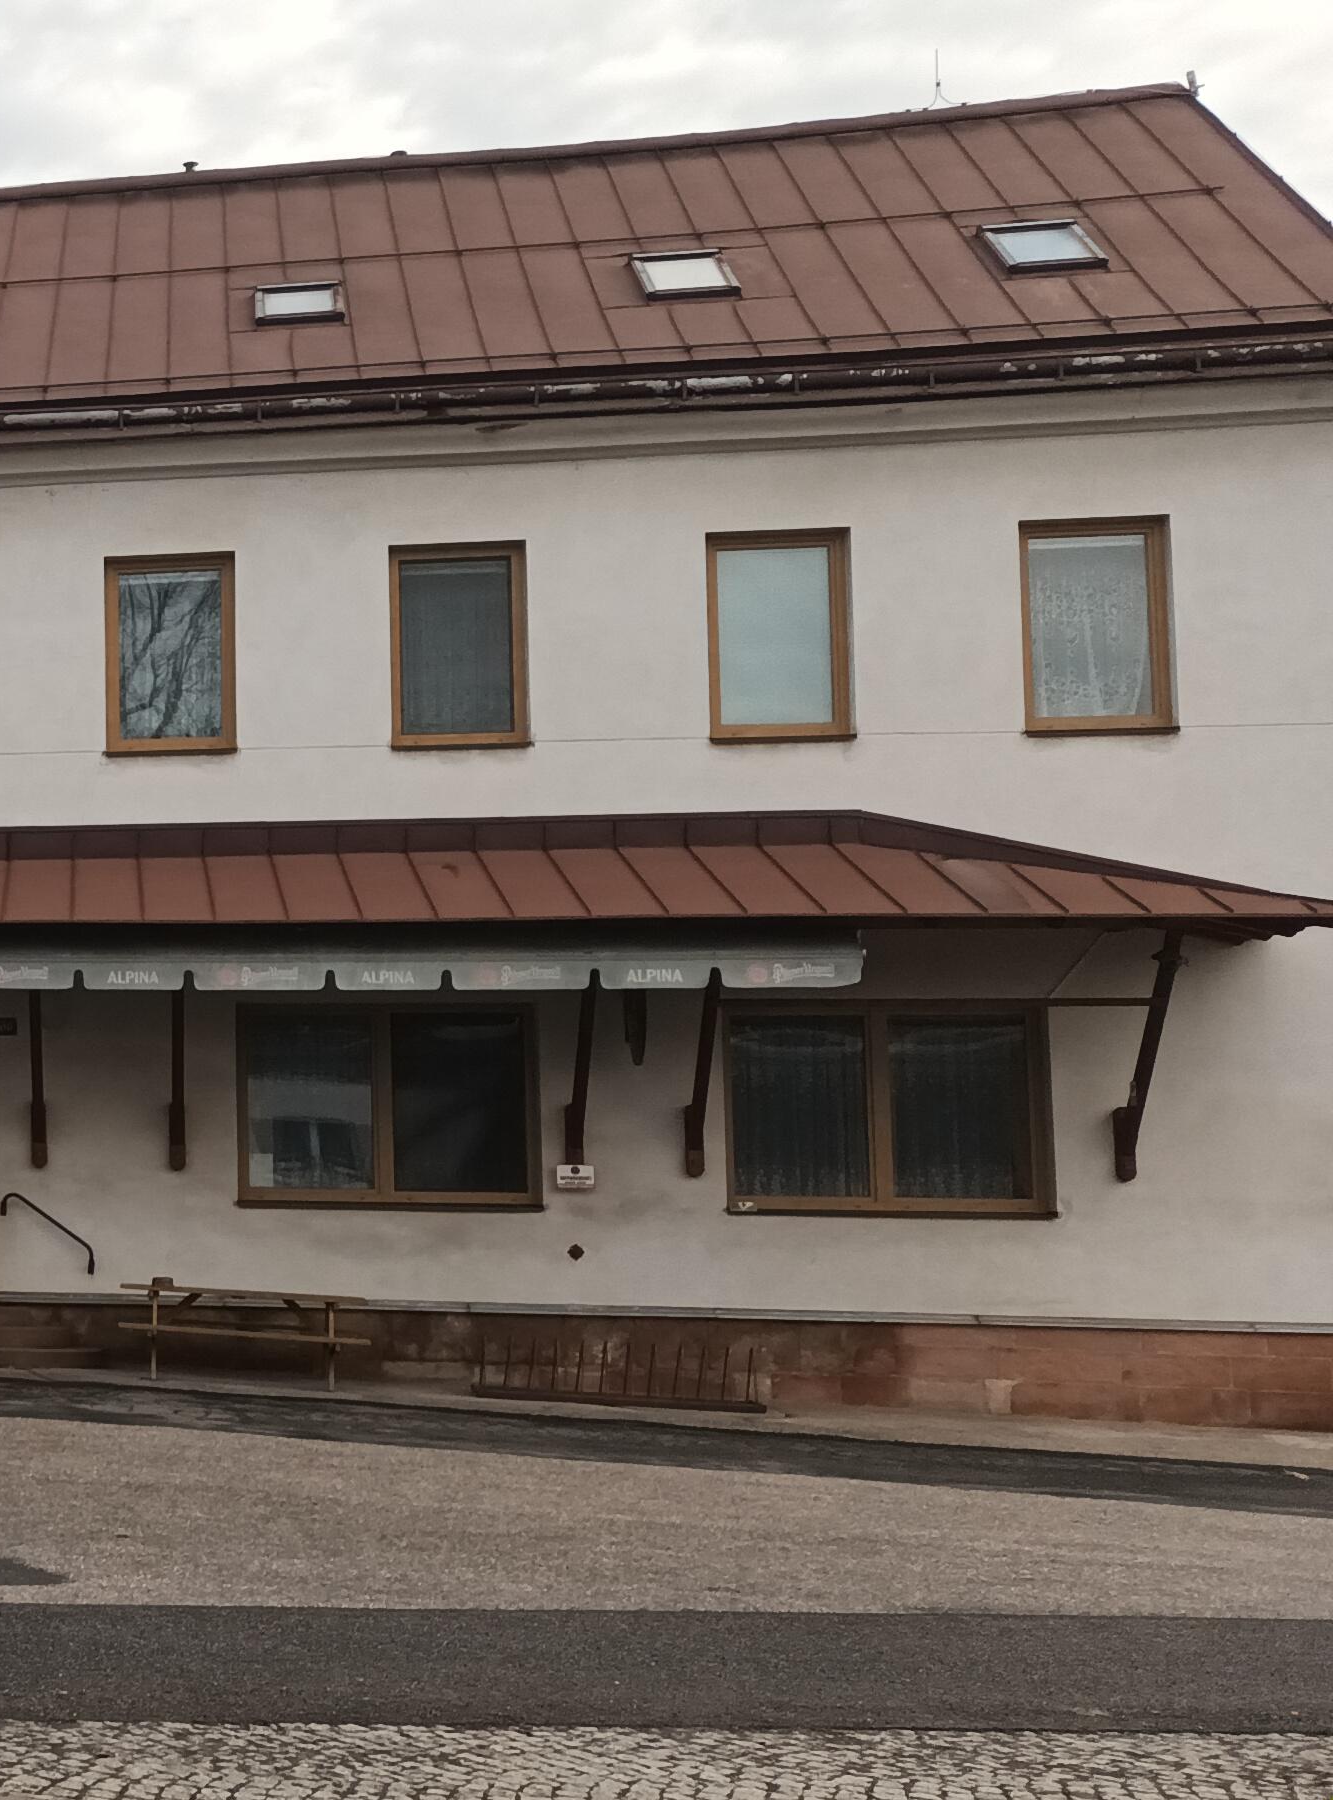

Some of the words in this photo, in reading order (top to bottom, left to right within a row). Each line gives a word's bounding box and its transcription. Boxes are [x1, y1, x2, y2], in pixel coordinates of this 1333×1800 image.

[107, 970, 159, 985] ALPINA
[362, 970, 415, 985] ALPINA
[627, 969, 683, 984] ALPINA
